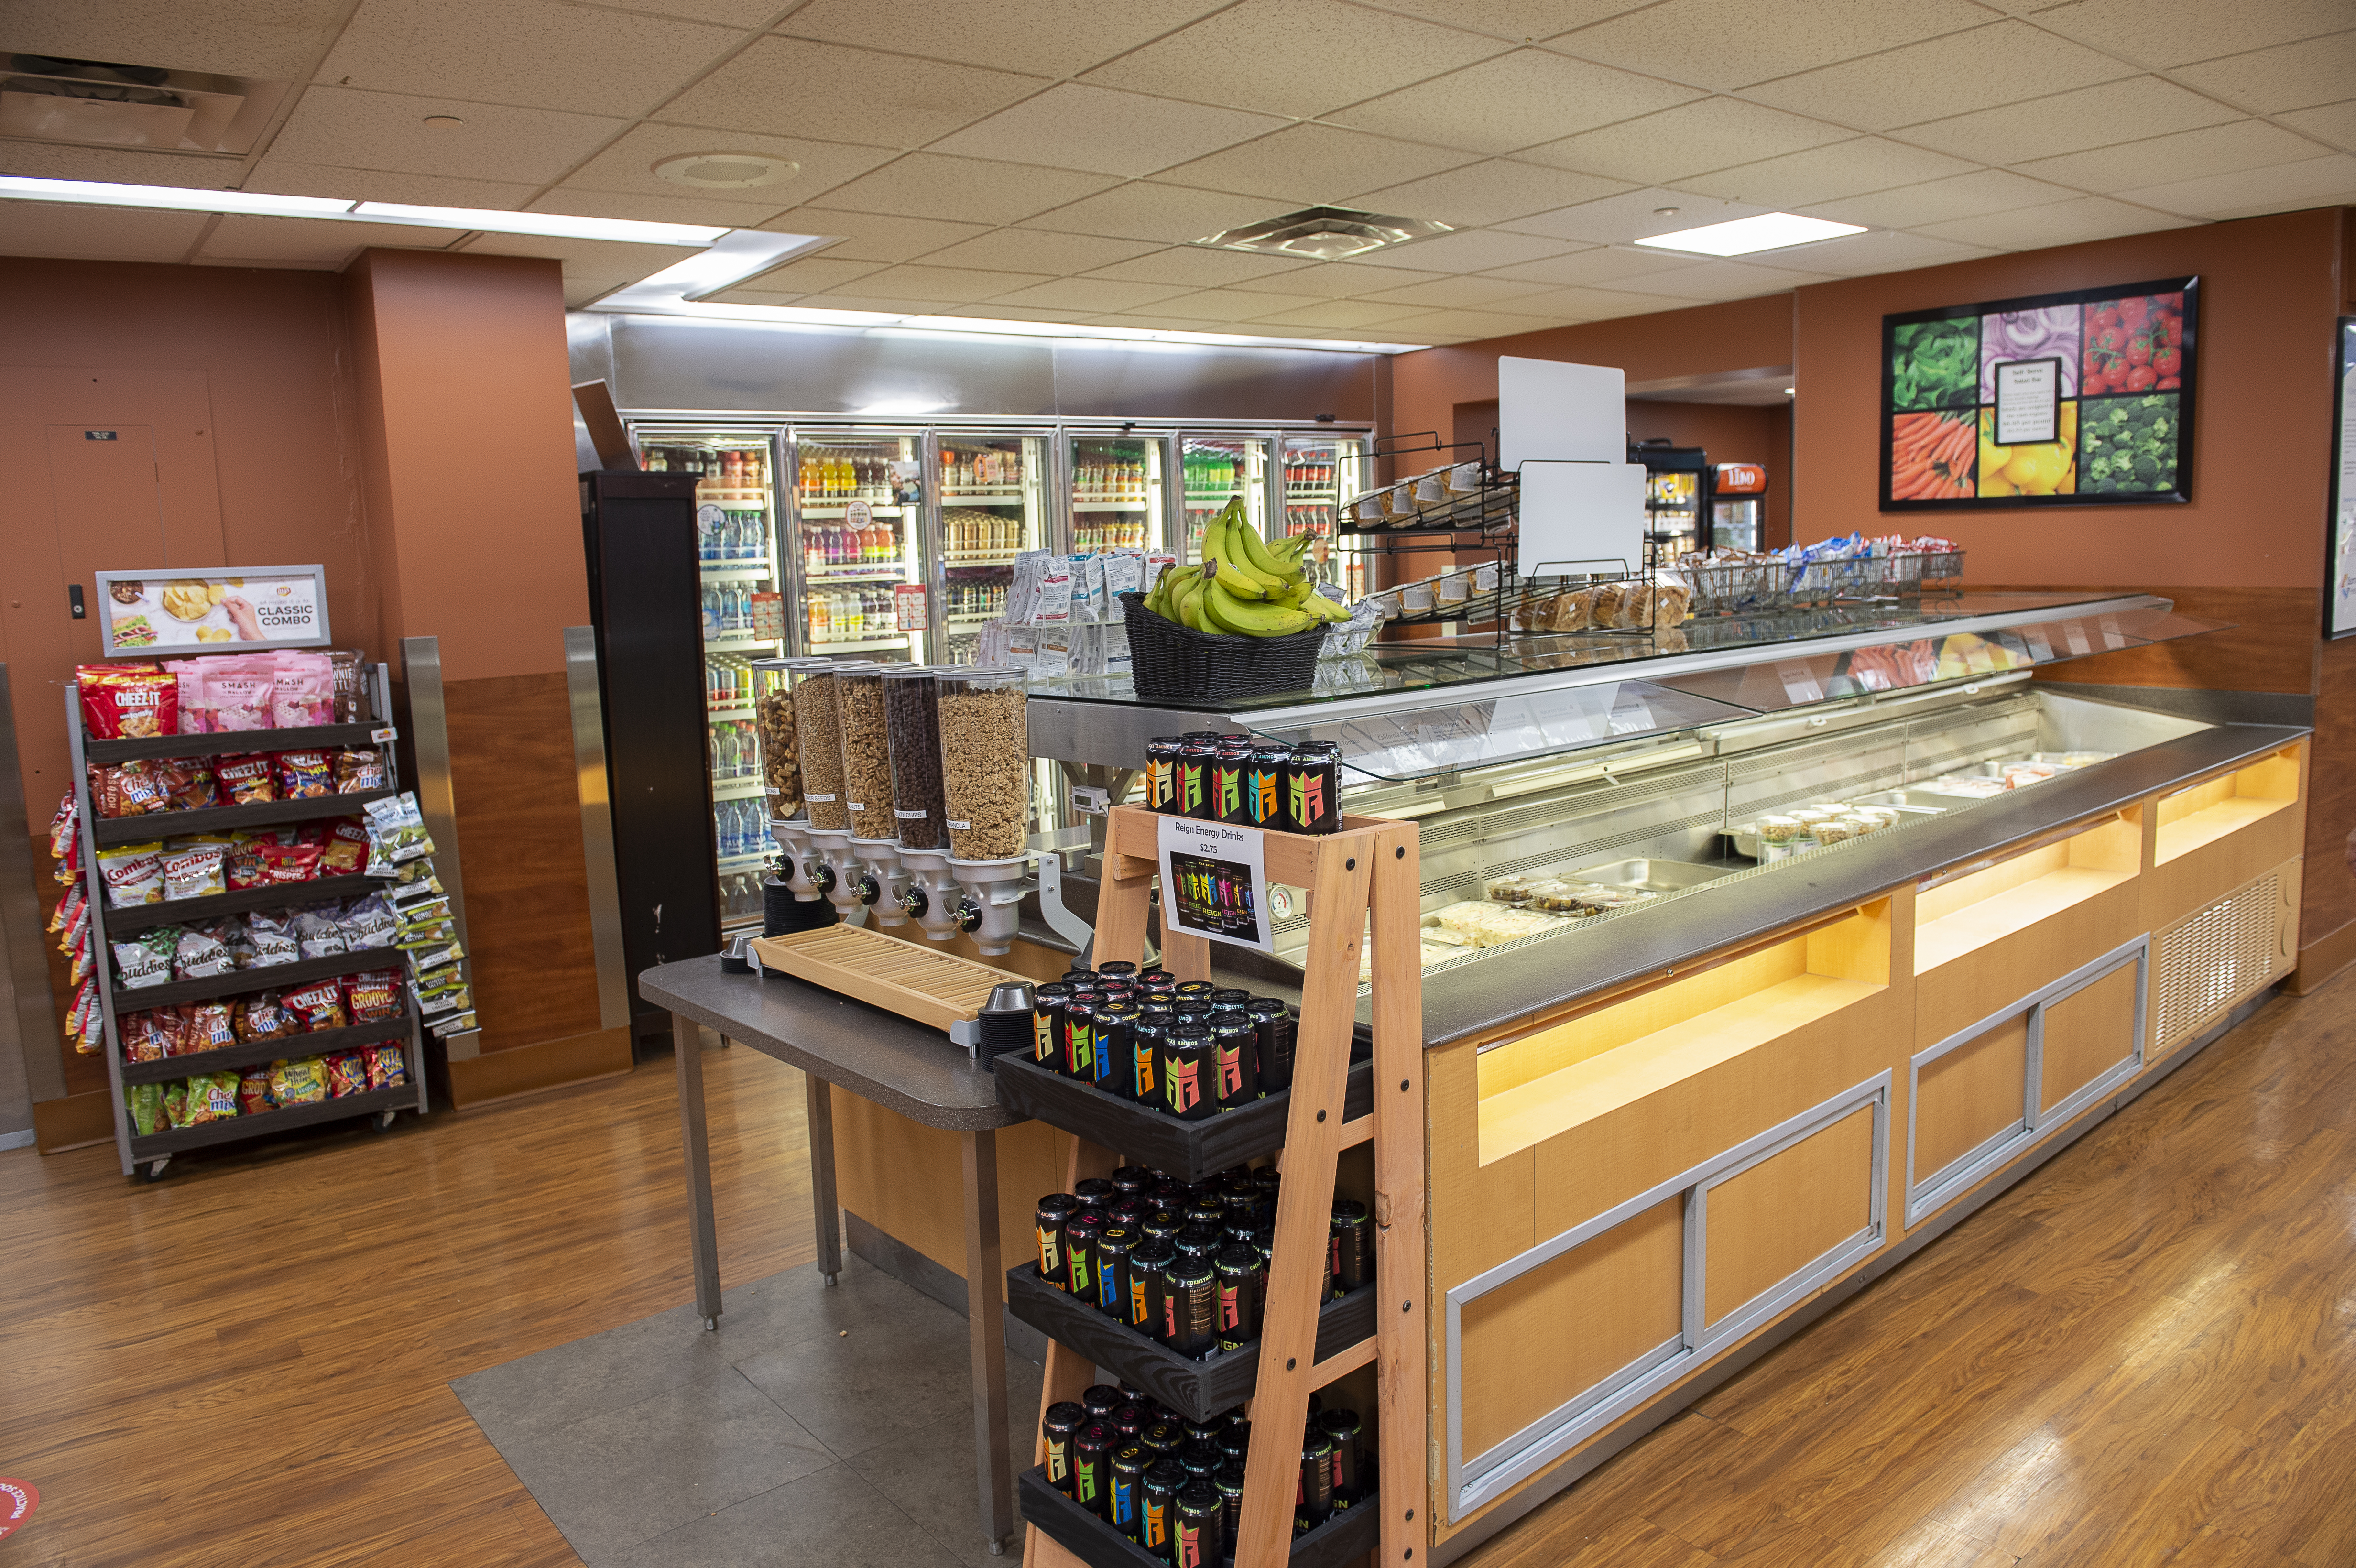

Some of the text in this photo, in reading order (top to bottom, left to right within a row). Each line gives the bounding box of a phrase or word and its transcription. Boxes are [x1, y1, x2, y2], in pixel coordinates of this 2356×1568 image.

[258, 605, 313, 616] CLASSIC
[262, 615, 311, 626] COMBO
[221, 682, 256, 690] SMASH
[1378, 732, 1399, 740] California
[131, 788, 154, 805] mix
[1175, 822, 1244, 842] Reign Energy Drinks
[1200, 843, 1217, 854] $2.75
[165, 850, 220, 875] Combos
[1202, 907, 1222, 917] REIGN
[121, 959, 170, 980] buddies
[366, 1007, 390, 1018] WIN
[210, 1100, 236, 1111] mix
[1115, 1463, 1132, 1471] AMINOS
[10, 1489, 28, 1520] PRACTICE
[1182, 1506, 1200, 1514] AMINOS
